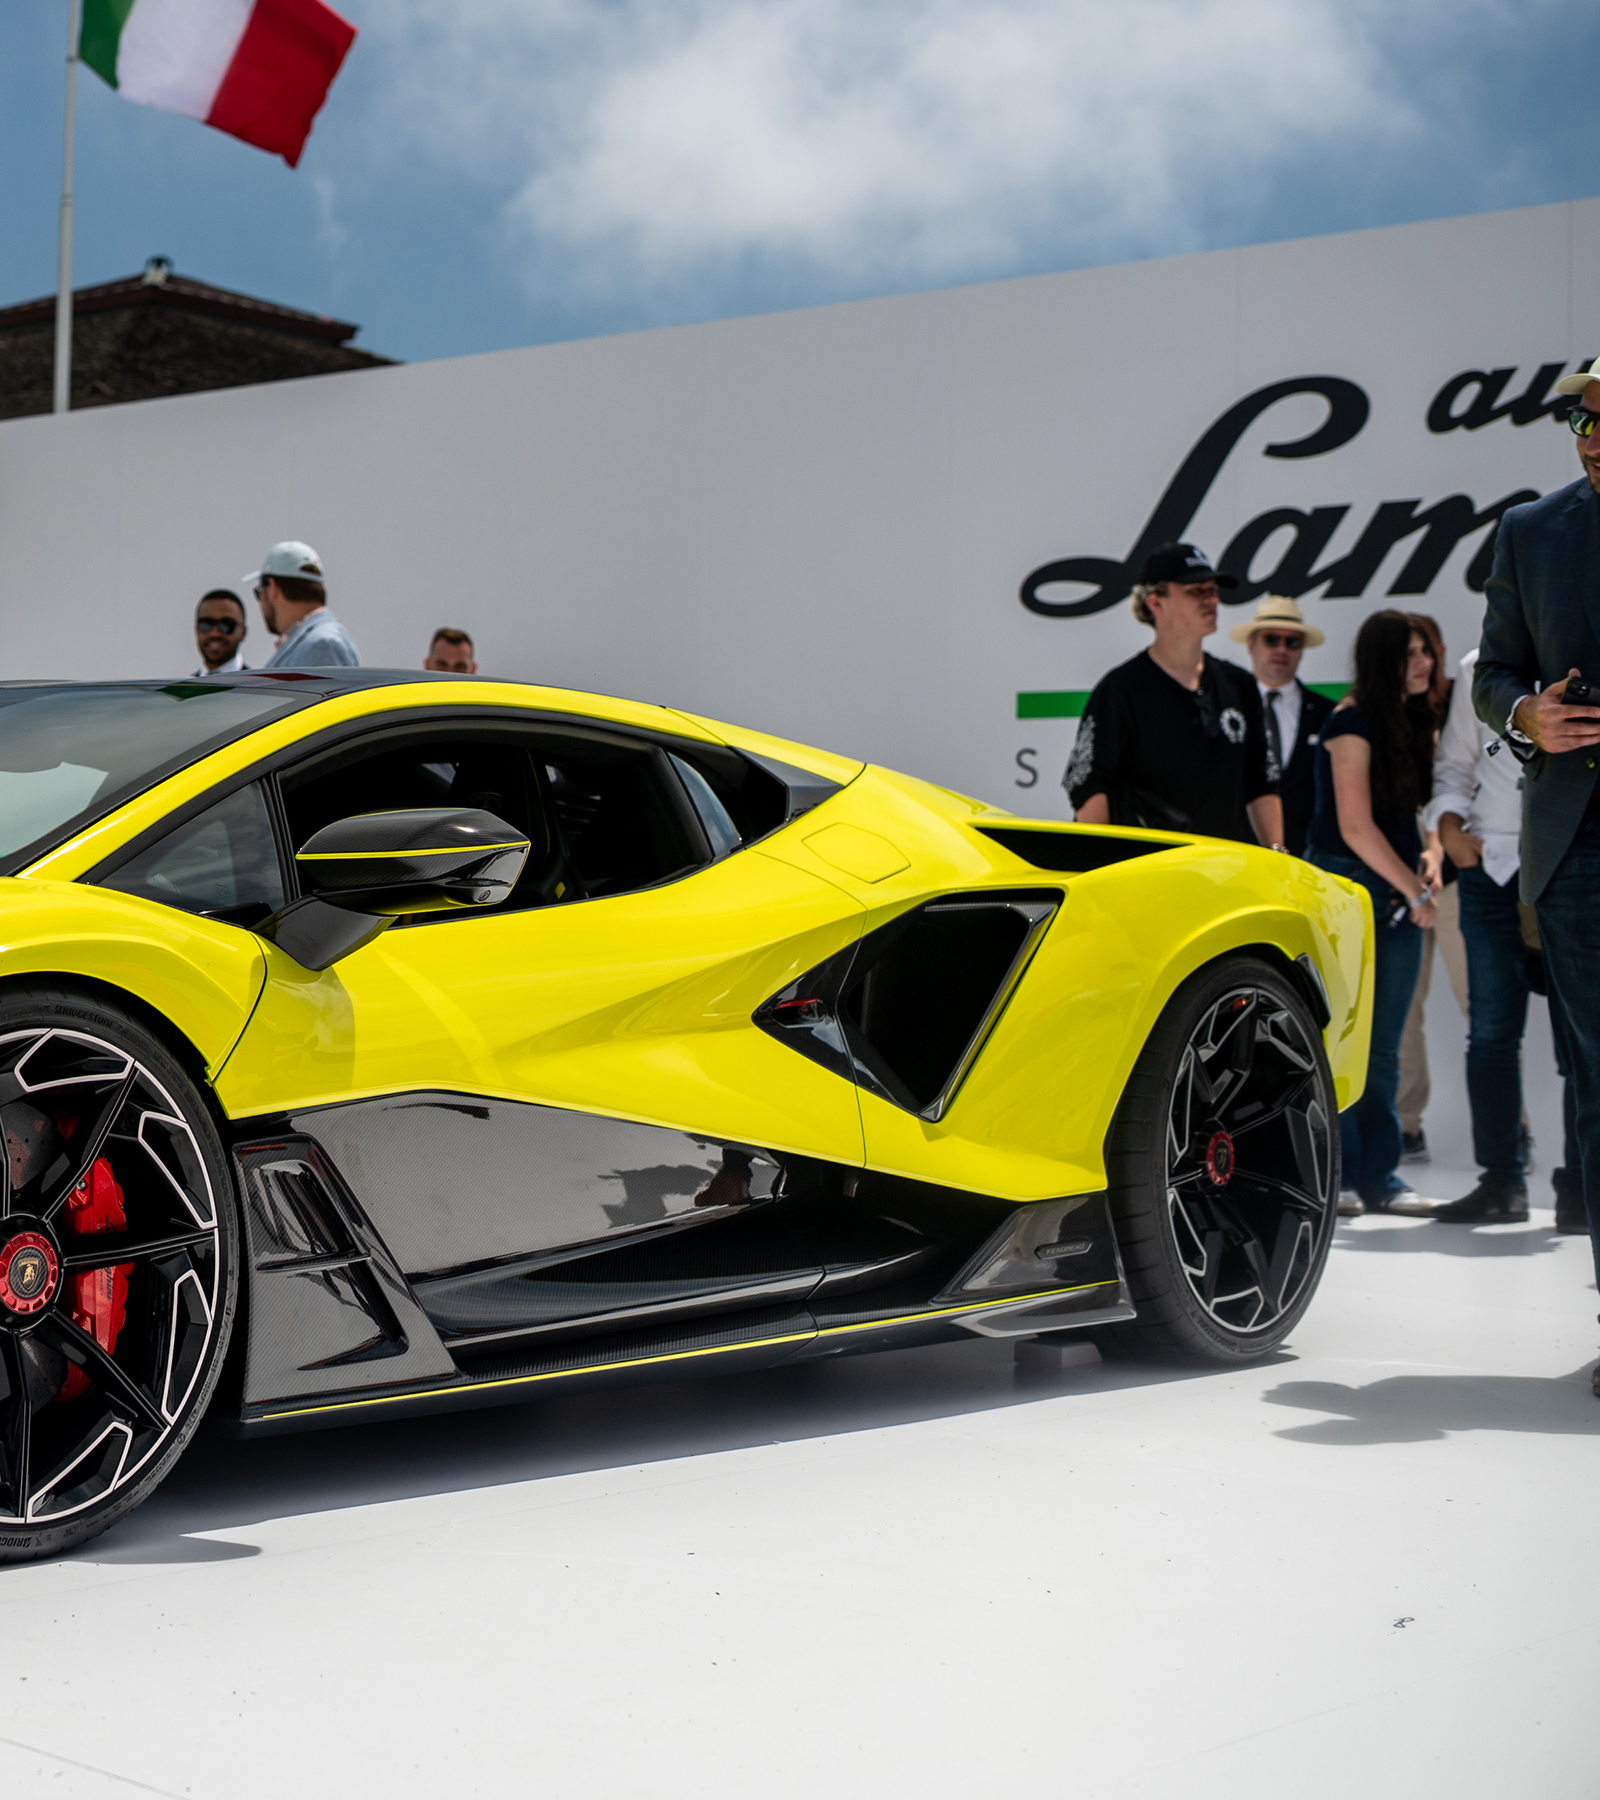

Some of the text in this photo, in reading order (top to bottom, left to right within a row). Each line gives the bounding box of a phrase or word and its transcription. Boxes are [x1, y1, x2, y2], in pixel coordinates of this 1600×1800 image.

[1020, 375, 1545, 617] Lam
[54, 1005, 114, 1029] BRIDGESTONE
[1046, 1243, 1085, 1255] FENOMENO
